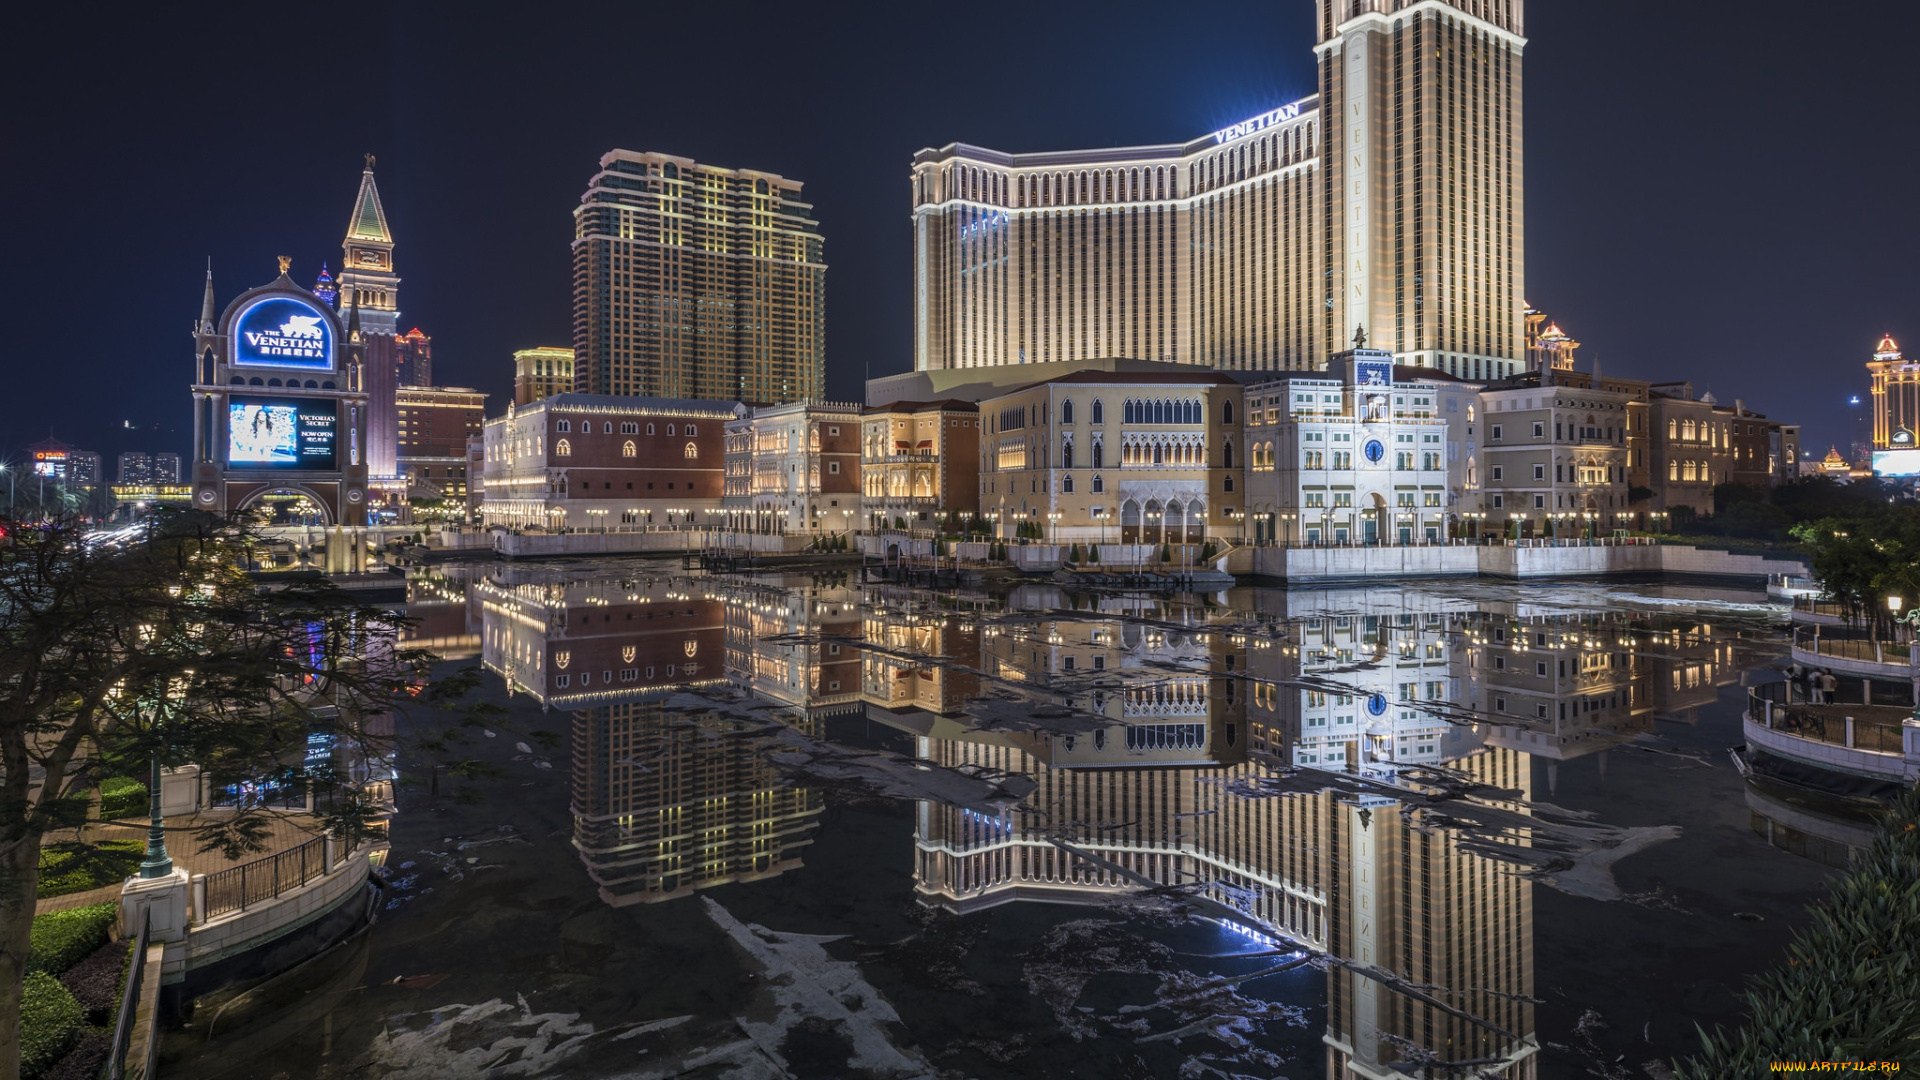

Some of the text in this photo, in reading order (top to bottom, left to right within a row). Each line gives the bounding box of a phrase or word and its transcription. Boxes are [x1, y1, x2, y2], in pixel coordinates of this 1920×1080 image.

[1214, 102, 1300, 144] VENETIAN
[1353, 102, 1362, 298] VENETIAN
[245, 332, 323, 349] VENETIAN
